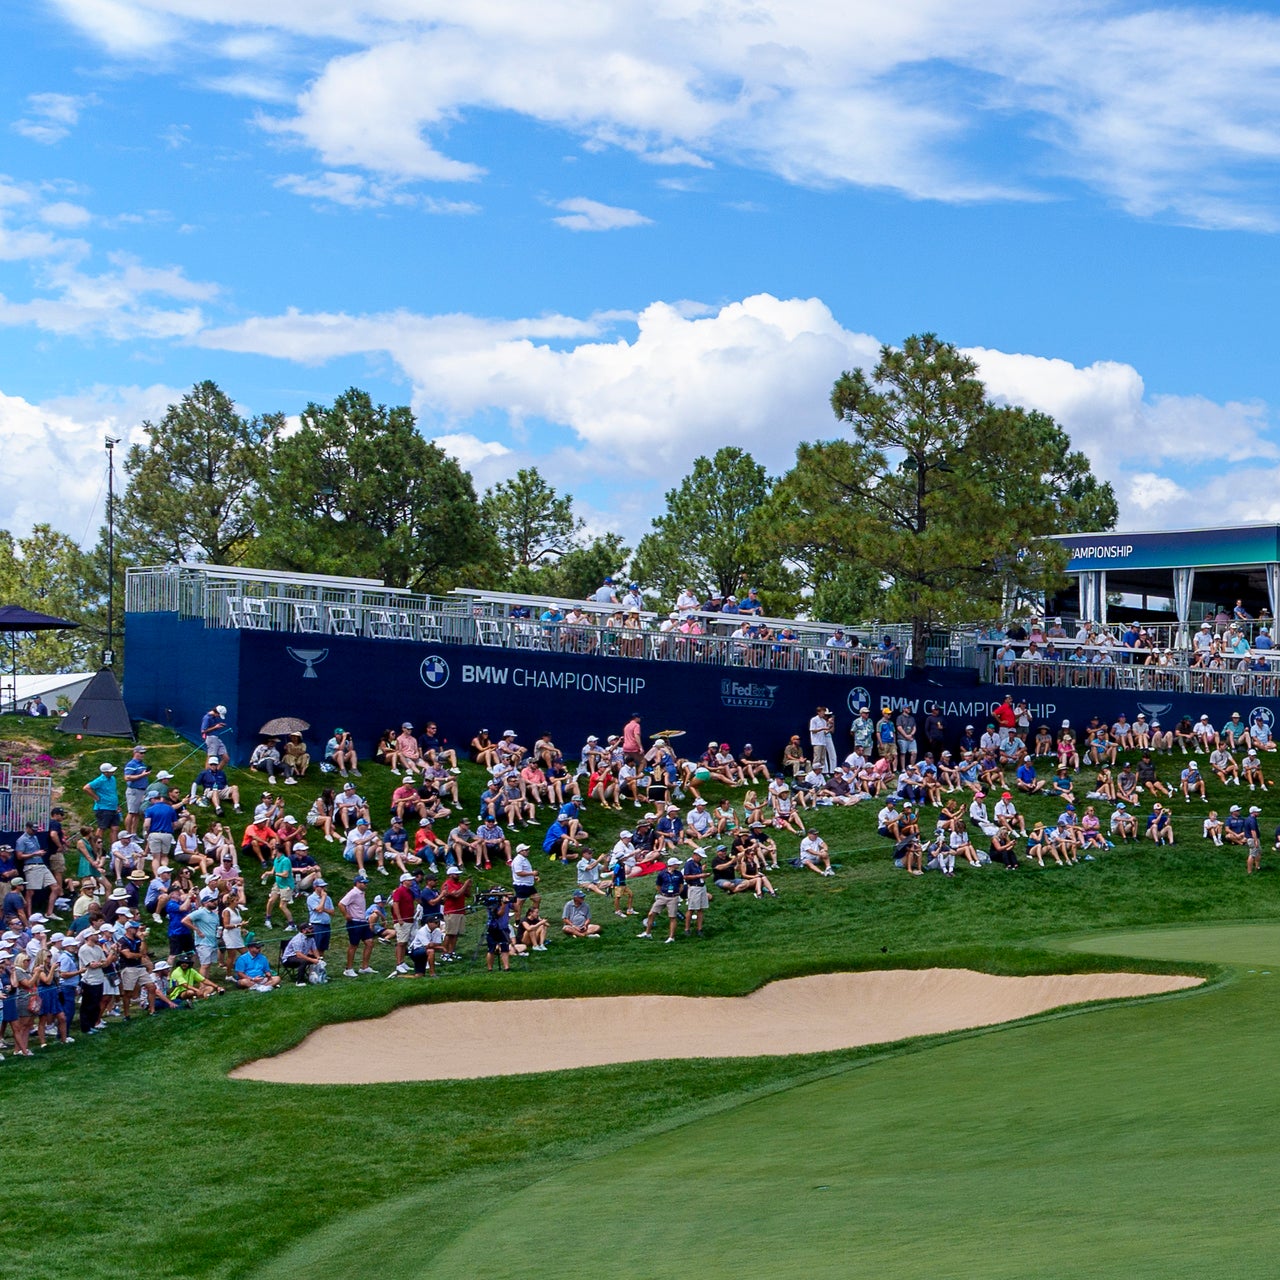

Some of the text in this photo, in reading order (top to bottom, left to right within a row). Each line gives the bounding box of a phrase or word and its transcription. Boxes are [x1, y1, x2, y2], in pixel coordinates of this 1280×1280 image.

[1071, 545, 1133, 559] AMPIONSHIP
[462, 665, 646, 695] BMW CHAMPIONSHIP
[732, 682, 765, 697] FedEx
[880, 695, 920, 714] BMW
